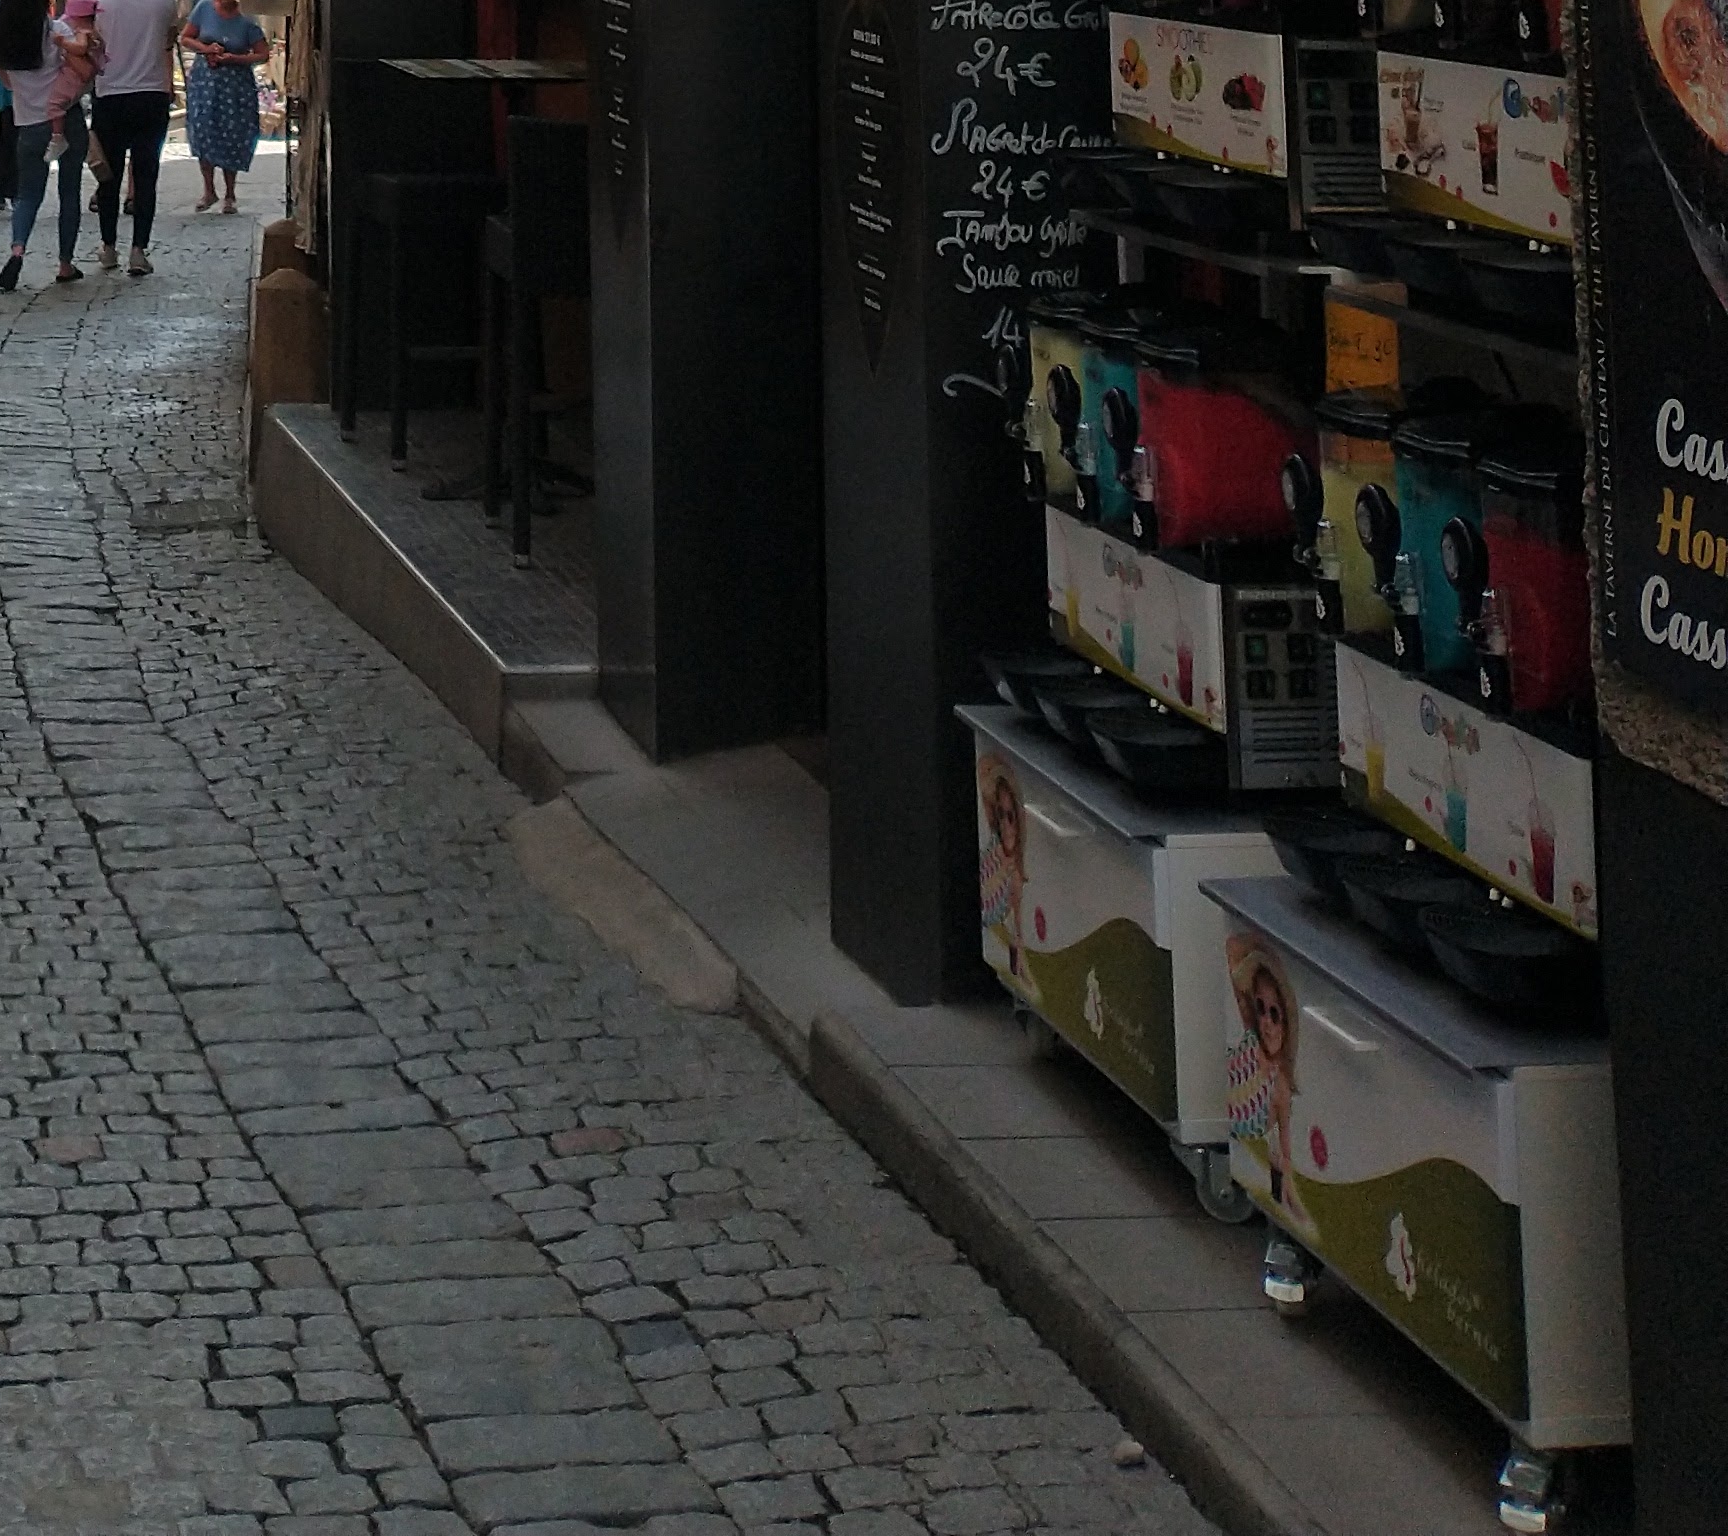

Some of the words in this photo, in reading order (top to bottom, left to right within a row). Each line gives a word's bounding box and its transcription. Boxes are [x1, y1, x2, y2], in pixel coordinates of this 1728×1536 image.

[1601, 455, 1613, 492] DU
[1655, 398, 1728, 484] Cas
[1603, 497, 1615, 599] TAVERNE
